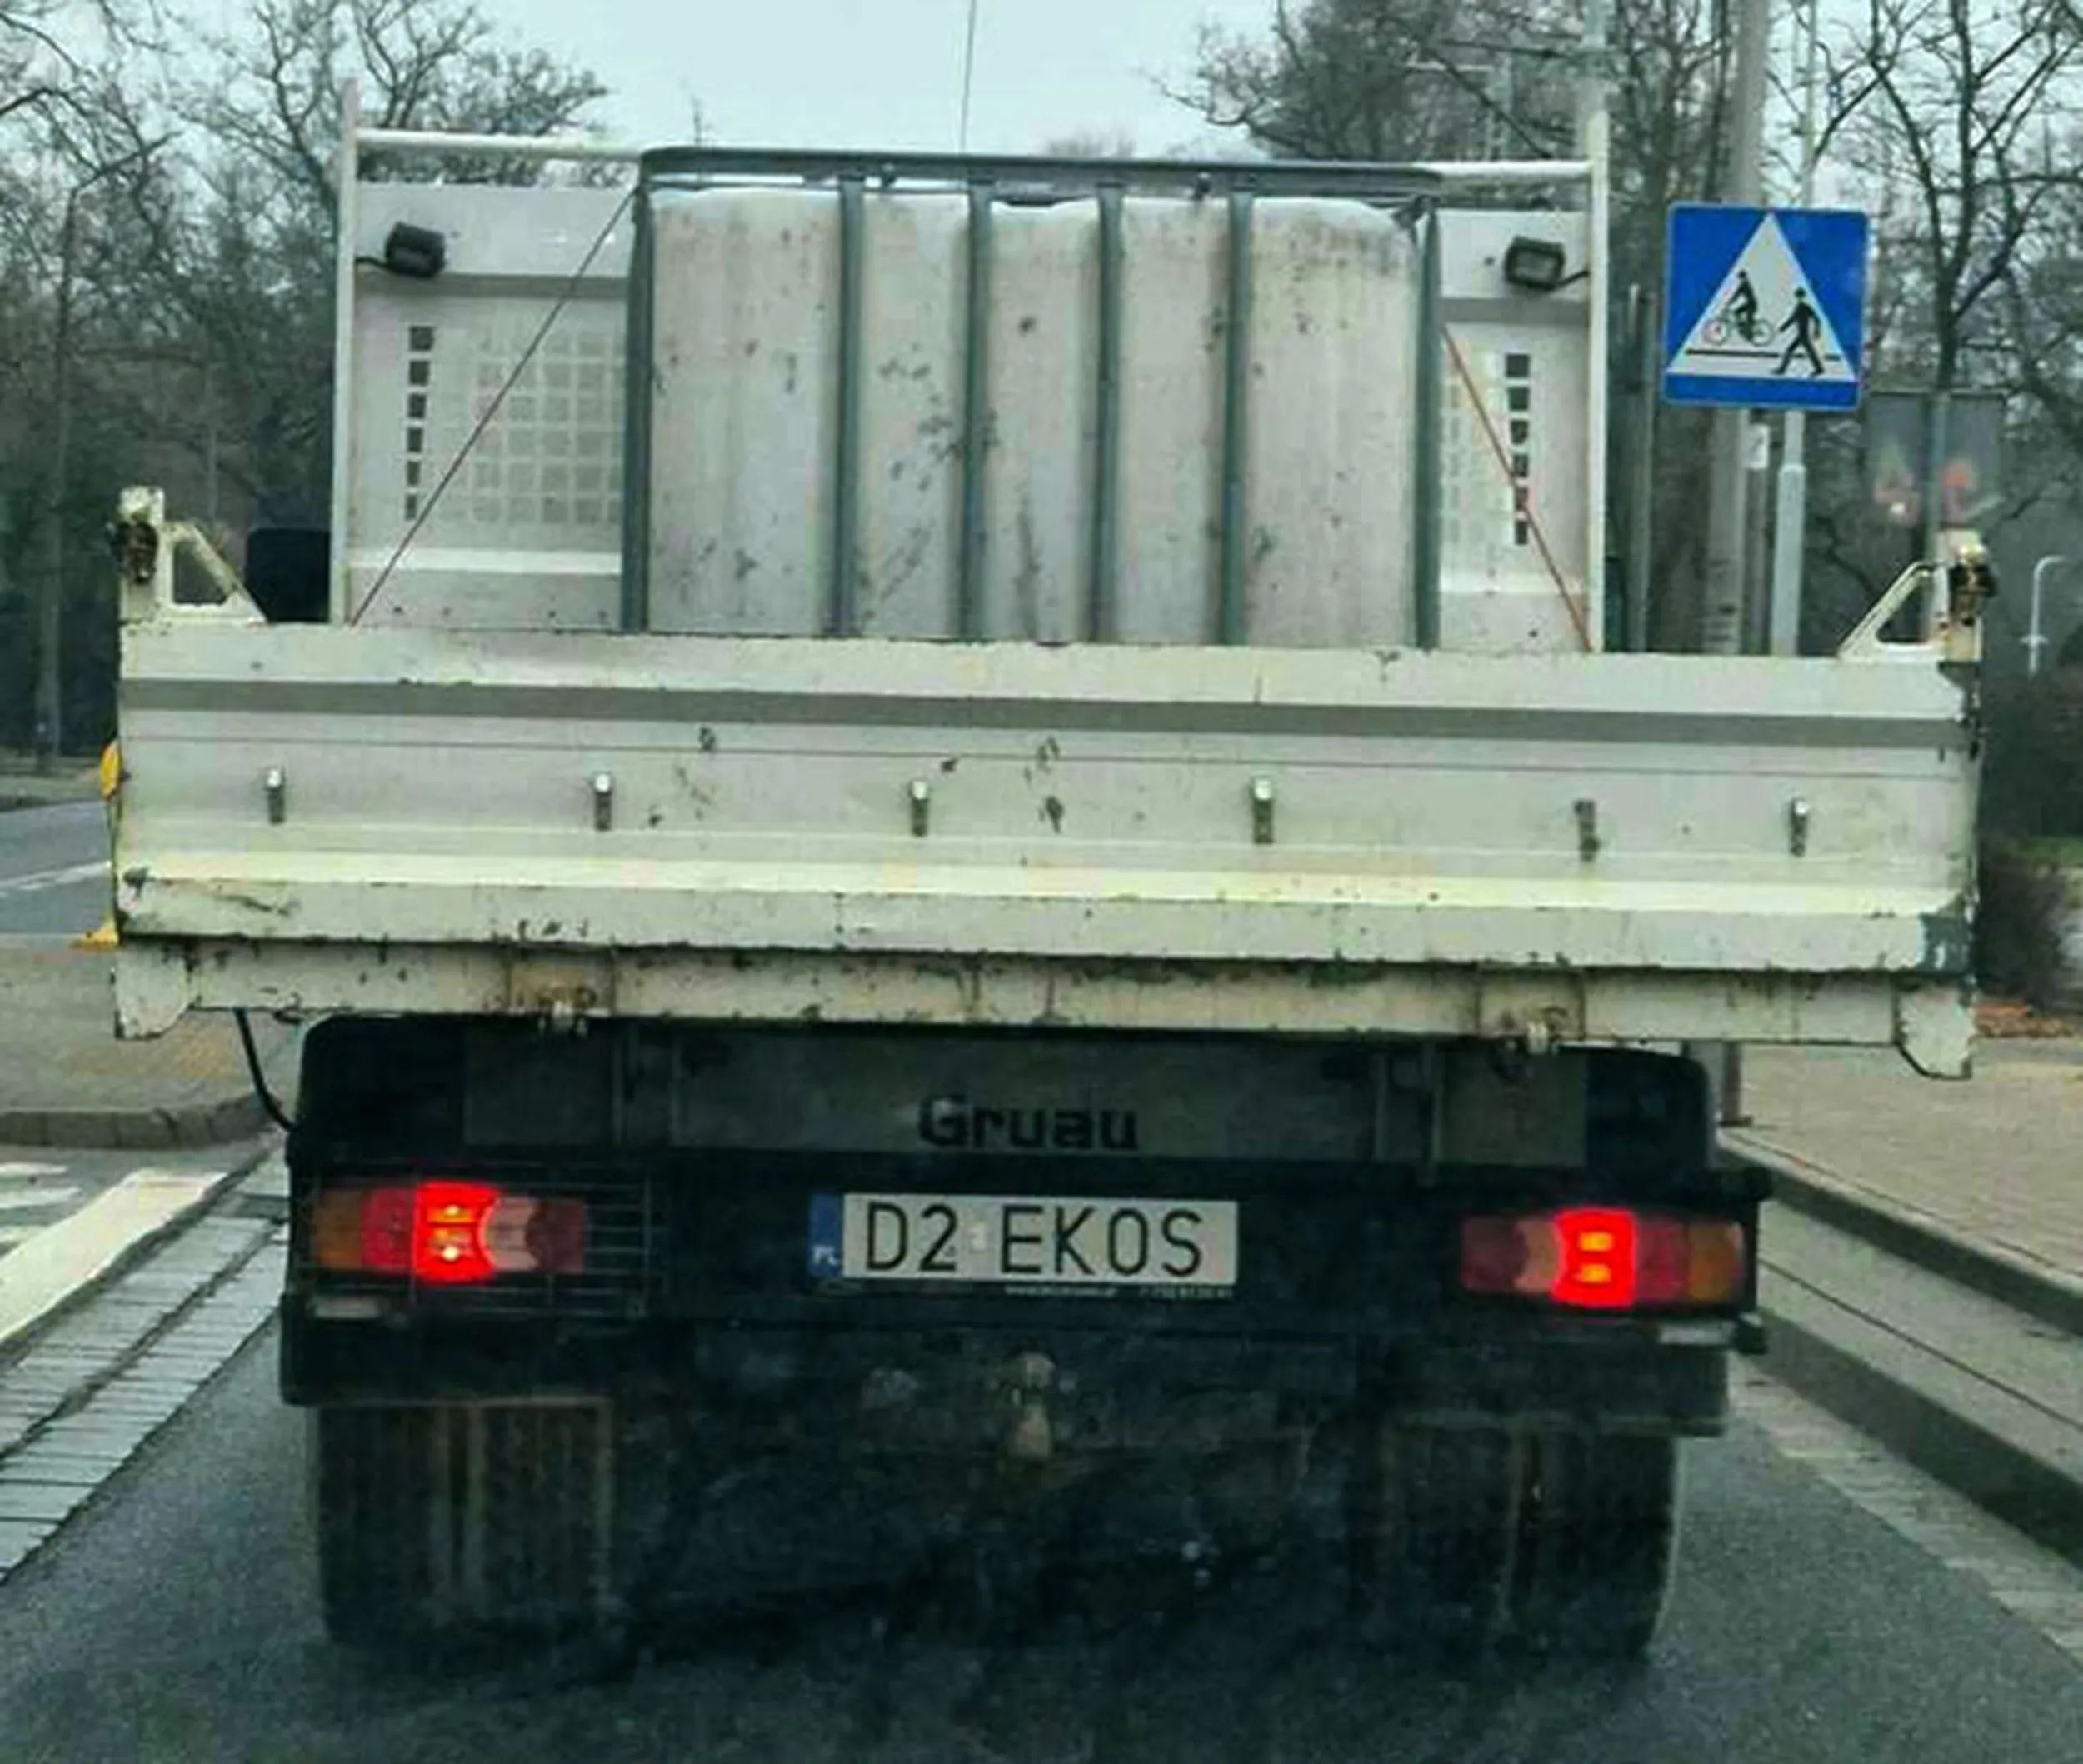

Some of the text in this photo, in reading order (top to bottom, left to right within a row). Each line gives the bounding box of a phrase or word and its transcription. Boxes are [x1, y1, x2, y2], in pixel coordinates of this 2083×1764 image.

[920, 1095, 1139, 1150] Gruau
[866, 1202, 1202, 1277] D2 EKOS
